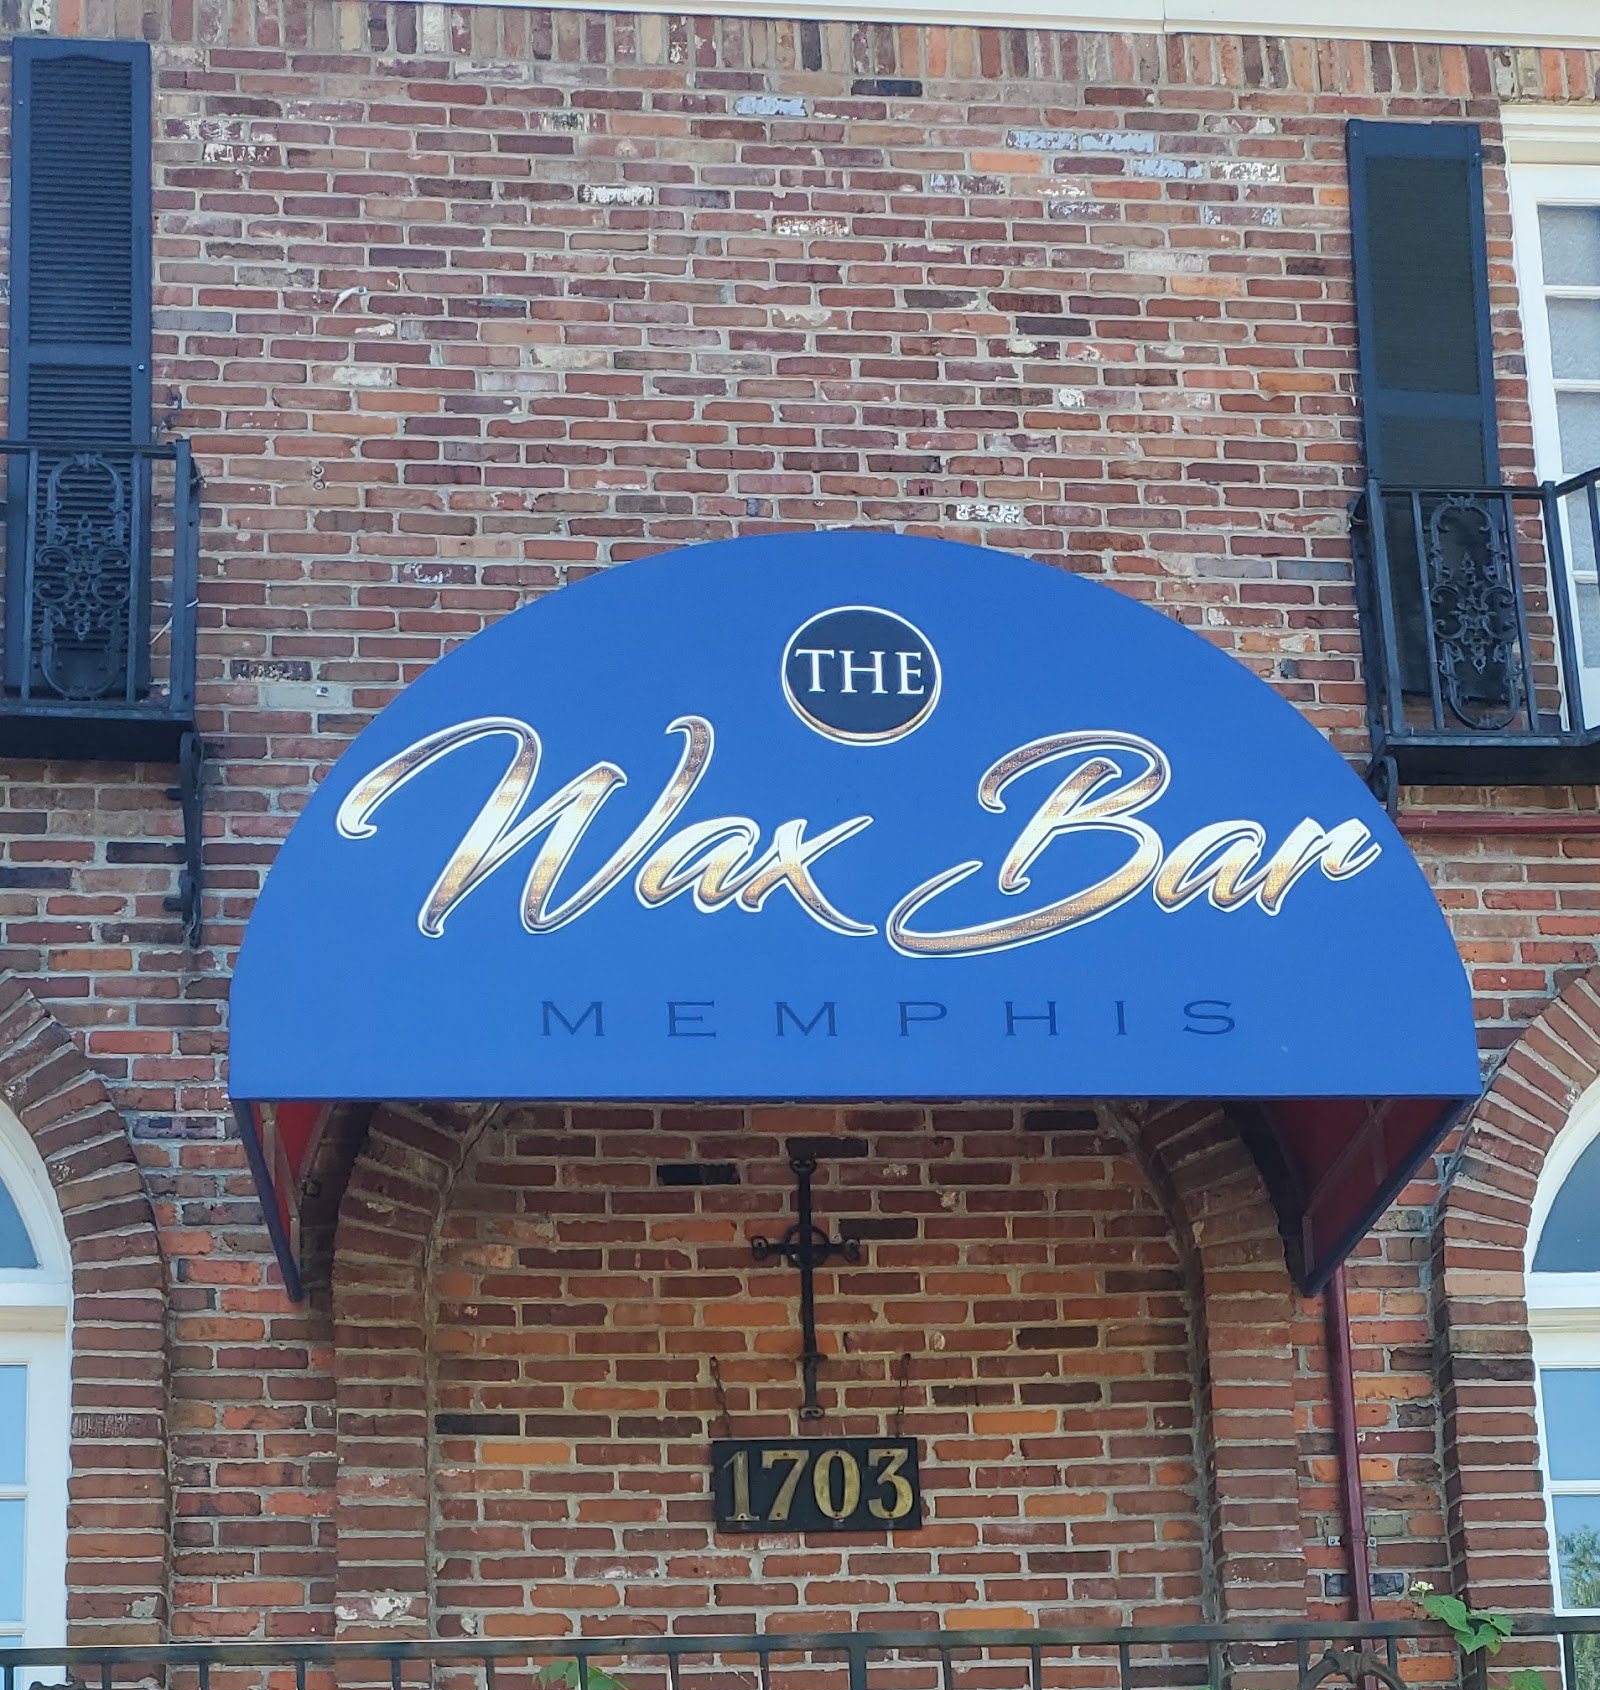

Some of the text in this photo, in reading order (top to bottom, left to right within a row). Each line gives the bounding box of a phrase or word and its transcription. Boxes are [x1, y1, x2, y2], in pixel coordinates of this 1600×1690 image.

[794, 648, 926, 695] THE
[336, 715, 1383, 959] Wax Bar
[539, 1000, 1237, 1038] MEMPHIS
[722, 1449, 913, 1521] 1703
